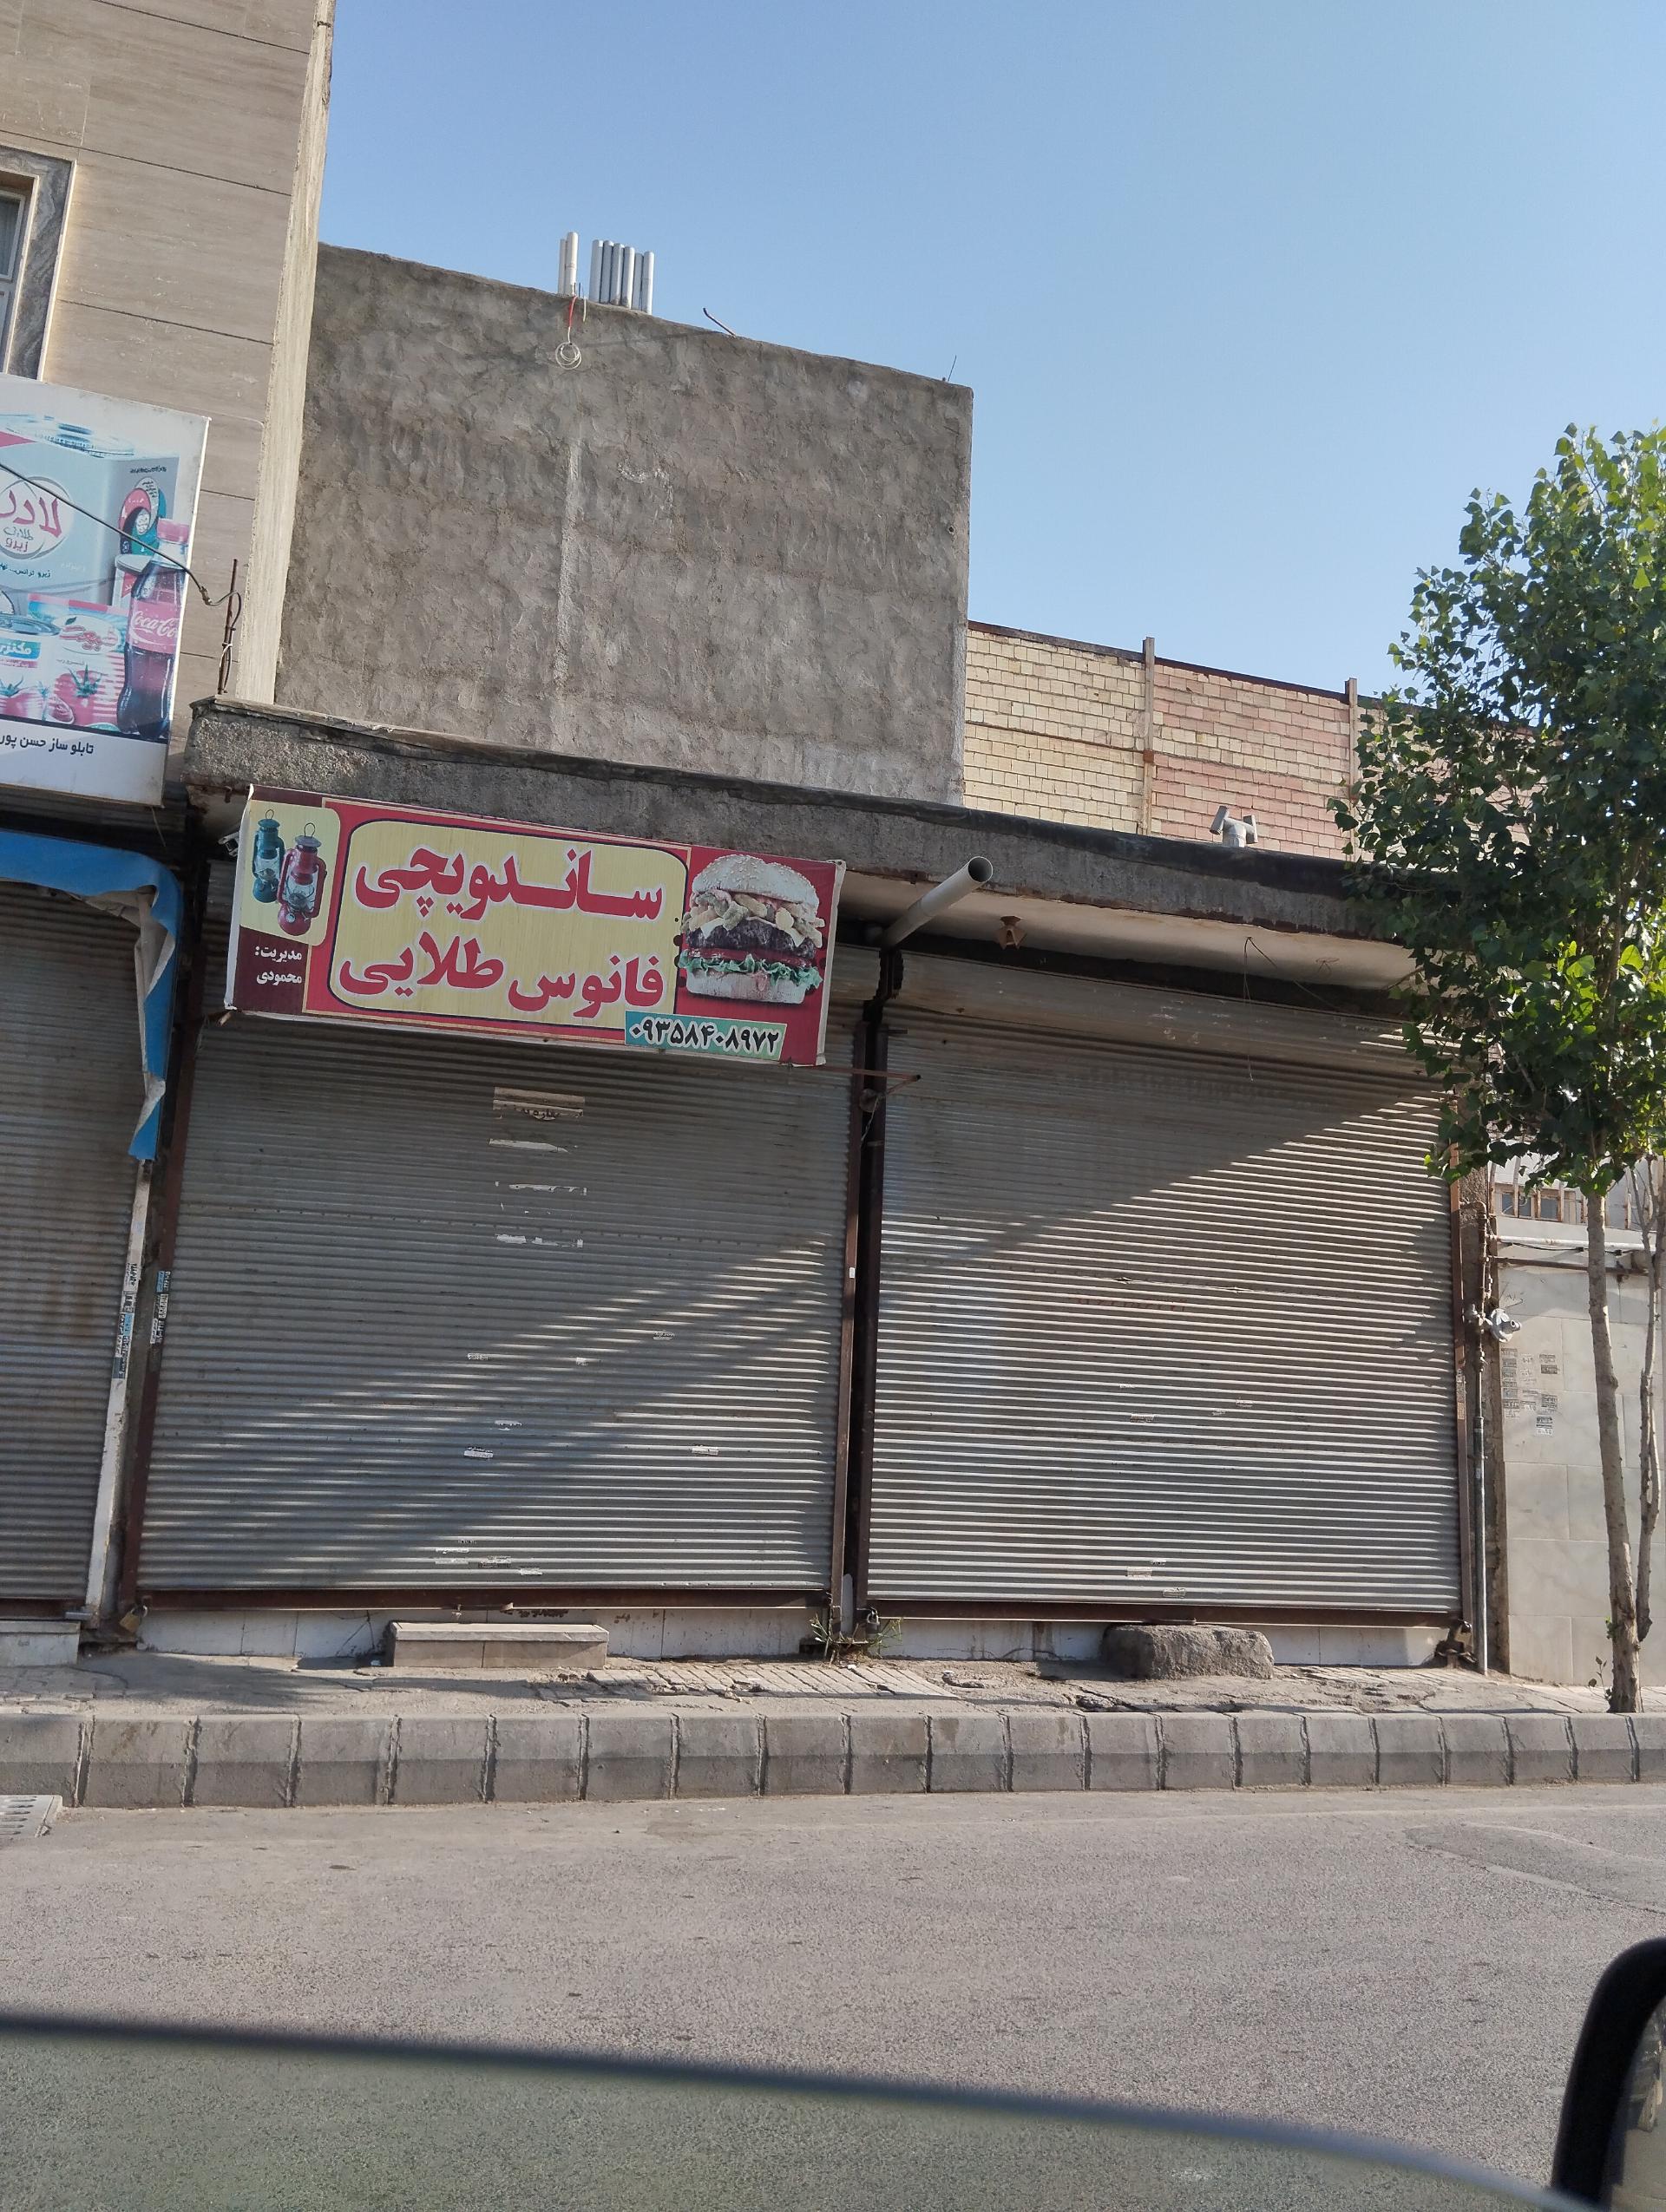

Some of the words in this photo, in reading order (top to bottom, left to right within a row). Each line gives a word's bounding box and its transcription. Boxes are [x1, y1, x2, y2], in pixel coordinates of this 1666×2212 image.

[5, 537, 29, 553] زیرو
[19, 736, 47, 749] حسن
[49, 737, 69, 753] ساز
[69, 742, 95, 756] تابلو
[355, 847, 663, 921] ساندویچی
[339, 931, 505, 998] طلایی
[256, 971, 302, 985] محمودی
[508, 954, 664, 1018] فانوس
[632, 1019, 779, 1053] ۰۹۳۵۸۴۰۸۹۷۲
